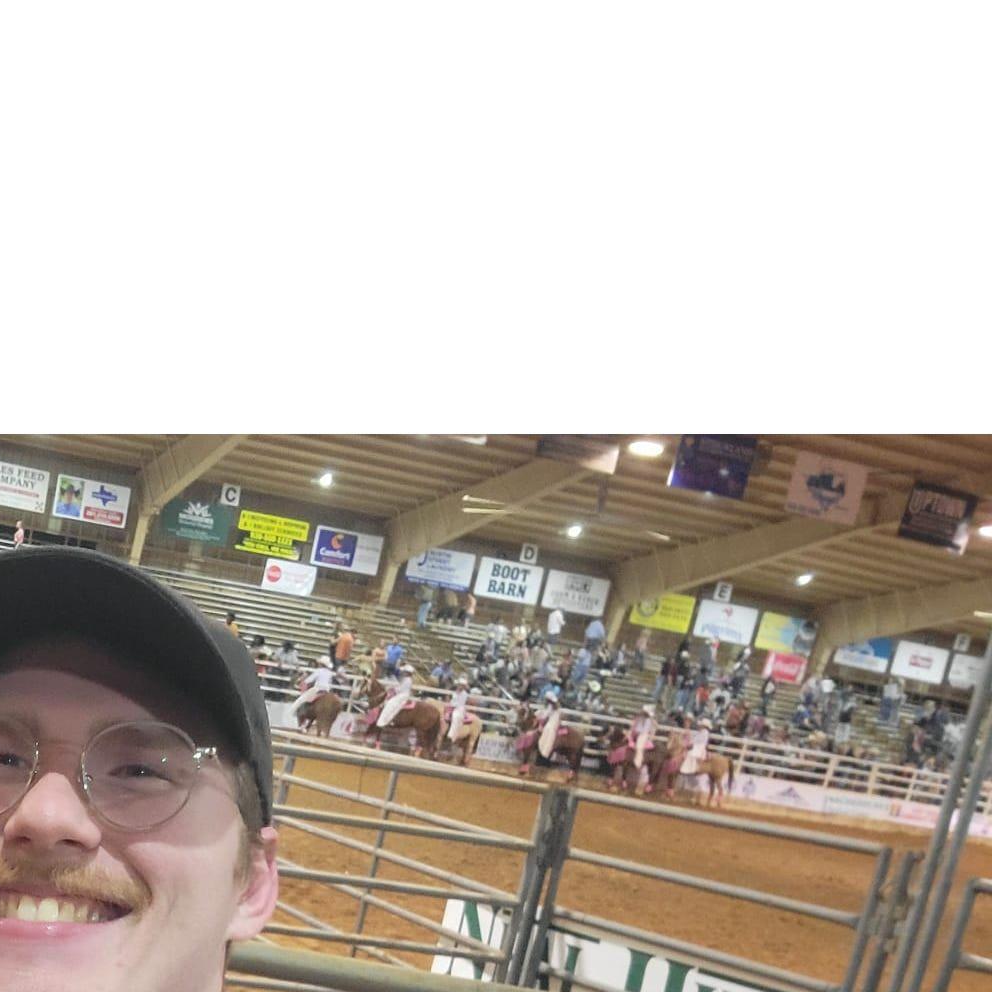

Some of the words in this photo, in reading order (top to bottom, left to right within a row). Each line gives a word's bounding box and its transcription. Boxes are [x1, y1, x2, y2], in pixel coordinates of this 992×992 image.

[17, 468, 45, 482] FEED
[225, 487, 237, 502] C
[524, 546, 535, 560] D
[491, 563, 531, 582] BOOT
[487, 580, 527, 598] BARN
[718, 584, 729, 599] E
